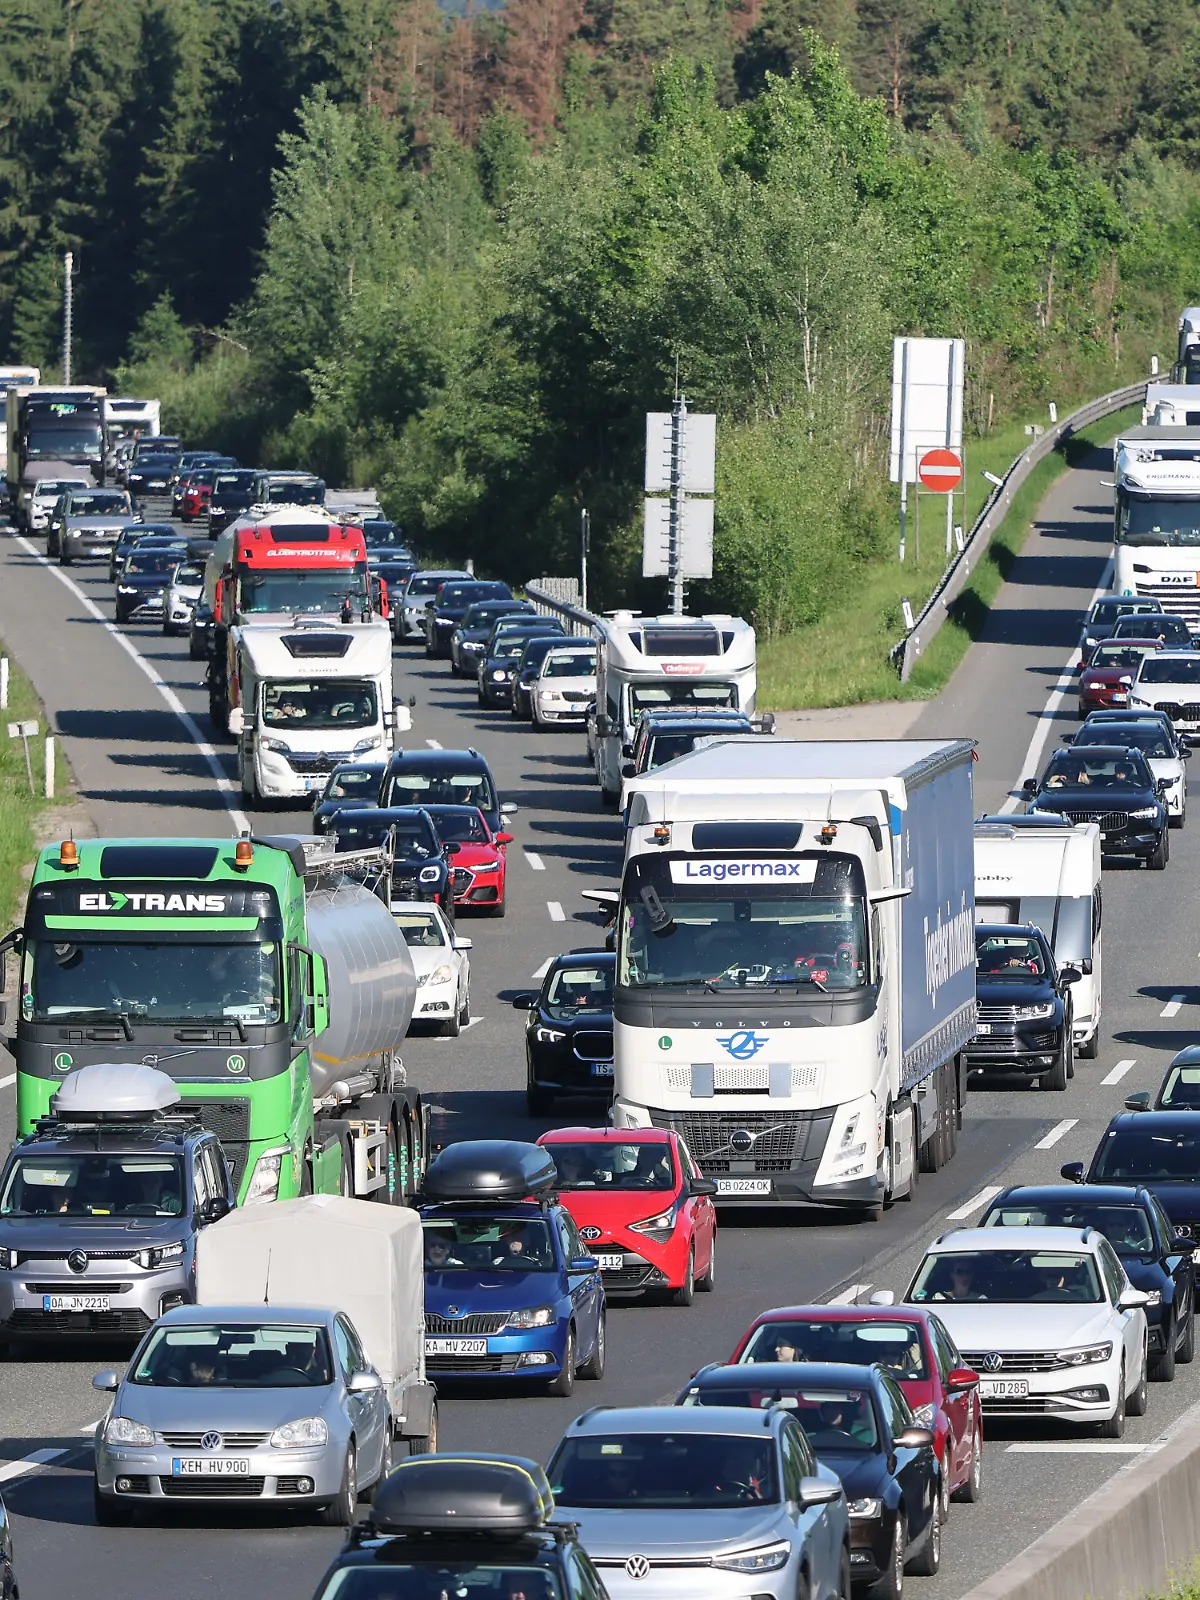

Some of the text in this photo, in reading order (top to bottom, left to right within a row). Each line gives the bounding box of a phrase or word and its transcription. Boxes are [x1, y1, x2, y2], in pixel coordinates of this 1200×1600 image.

[266, 549, 338, 557] GLOBETROTTER
[666, 664, 700, 674] Challenger
[686, 862, 801, 881] Lagermax
[974, 875, 1013, 883] obby
[596, 1064, 608, 1074] TS
[719, 1181, 769, 1191] CB 0224 OK
[602, 1256, 622, 1266] 112
[51, 1297, 109, 1309] OA JN 2215
[425, 1340, 485, 1352] KA MV 2207
[992, 1382, 1006, 1394] VD
[1007, 1382, 1026, 1394] 285
[181, 1460, 247, 1473] KEH HV 900
